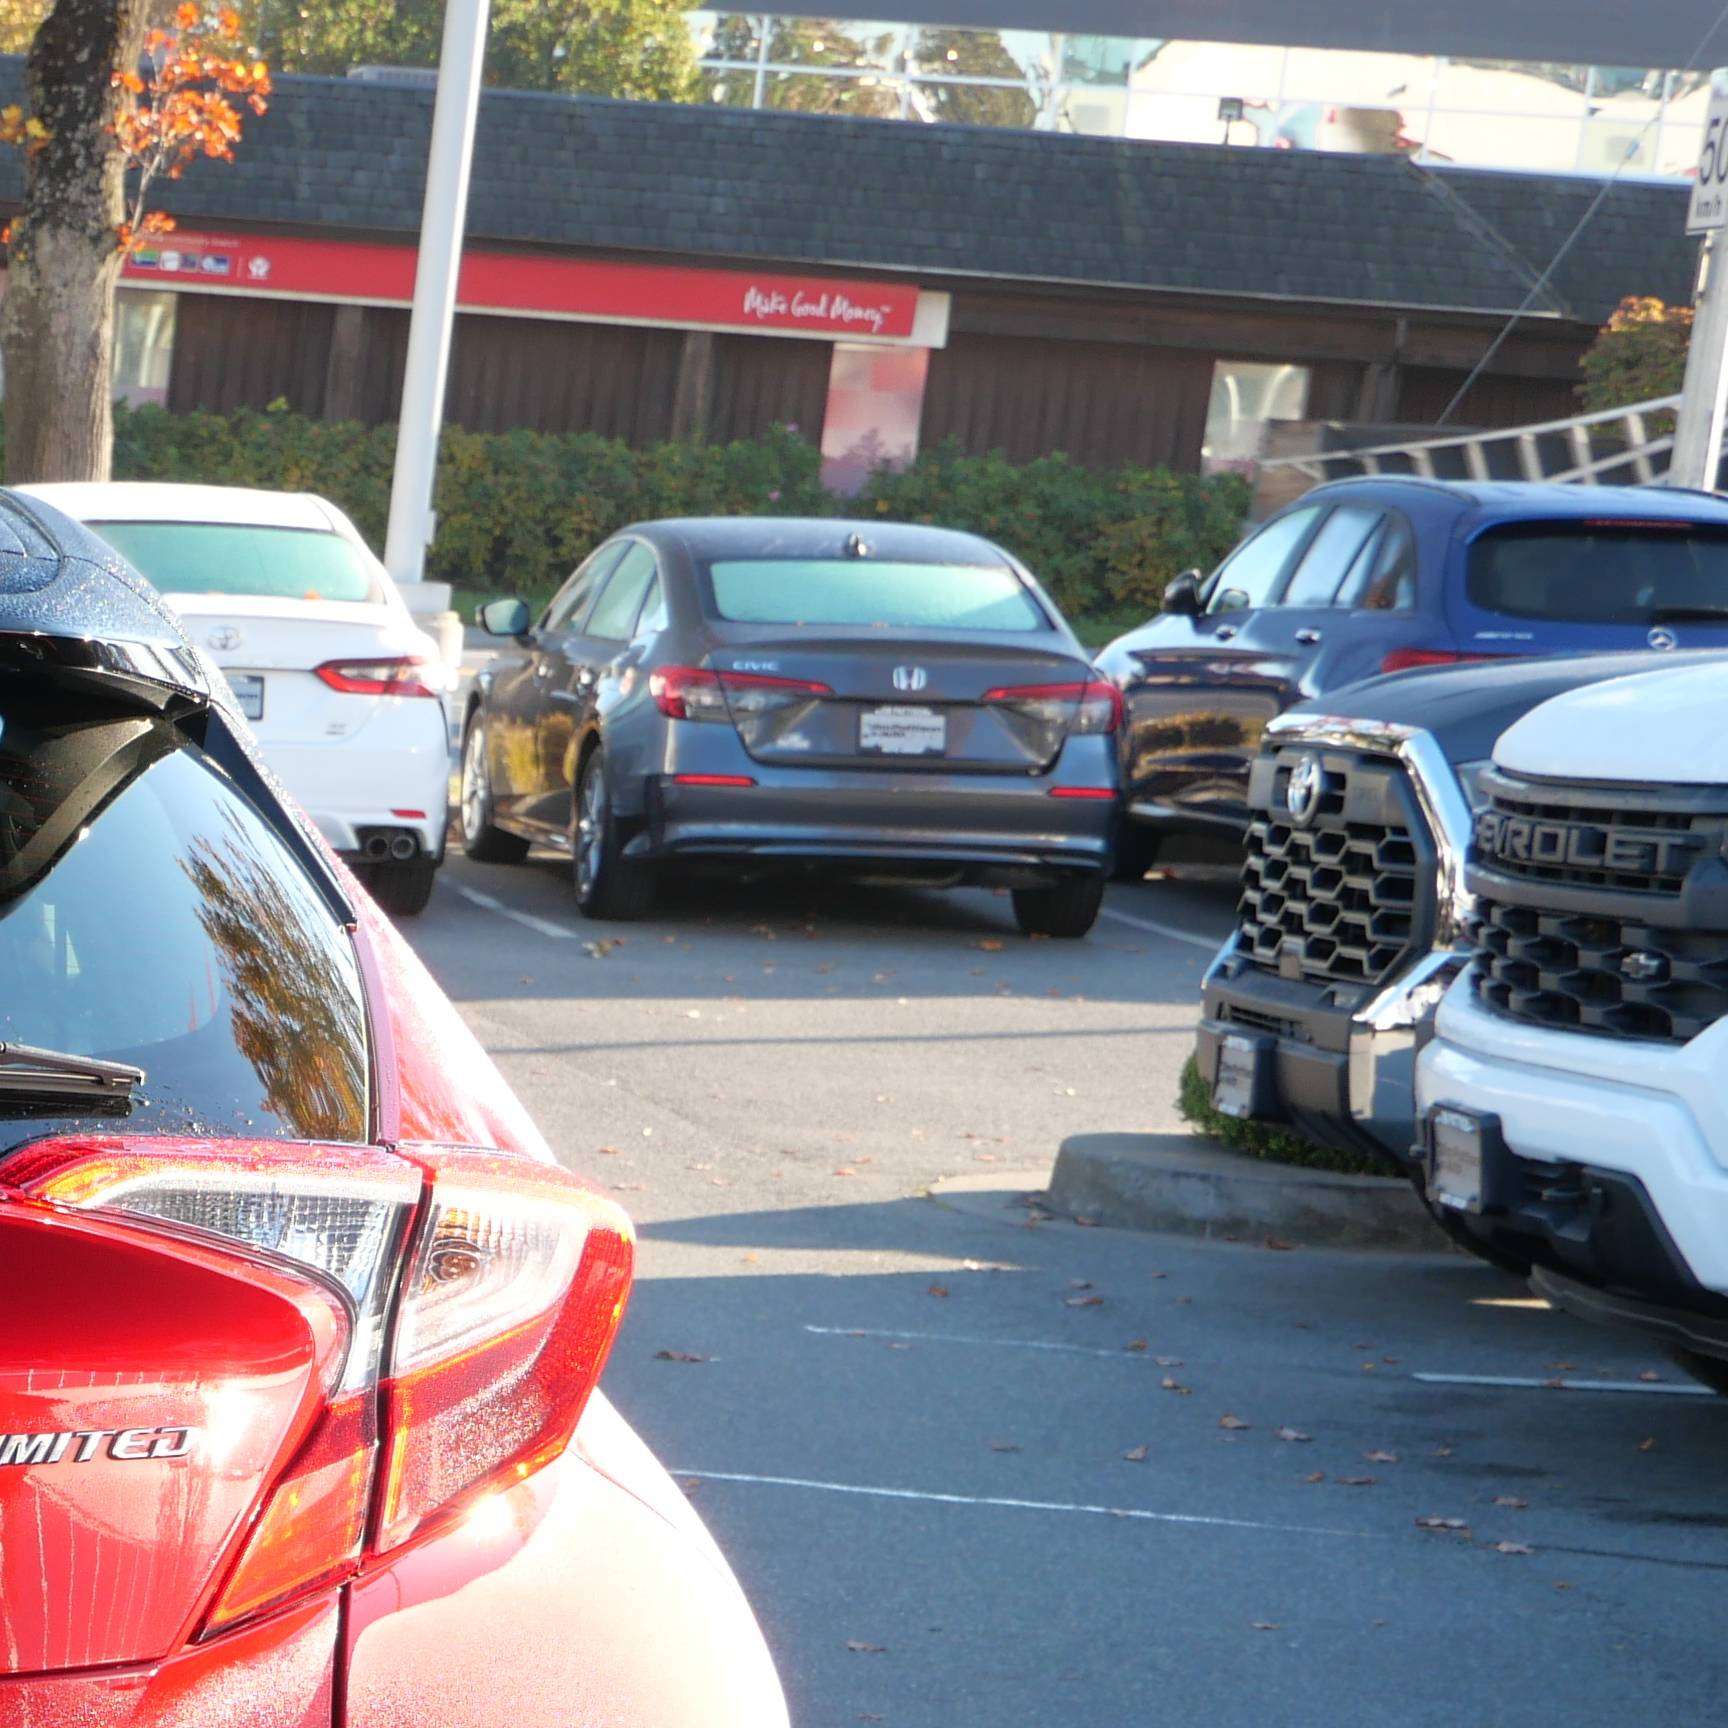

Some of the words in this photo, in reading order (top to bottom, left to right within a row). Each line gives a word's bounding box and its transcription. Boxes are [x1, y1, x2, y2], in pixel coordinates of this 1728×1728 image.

[744, 285, 787, 319] Make
[791, 290, 829, 318] Good
[732, 660, 780, 672] CIVIC
[1474, 812, 1685, 873] EVROLET
